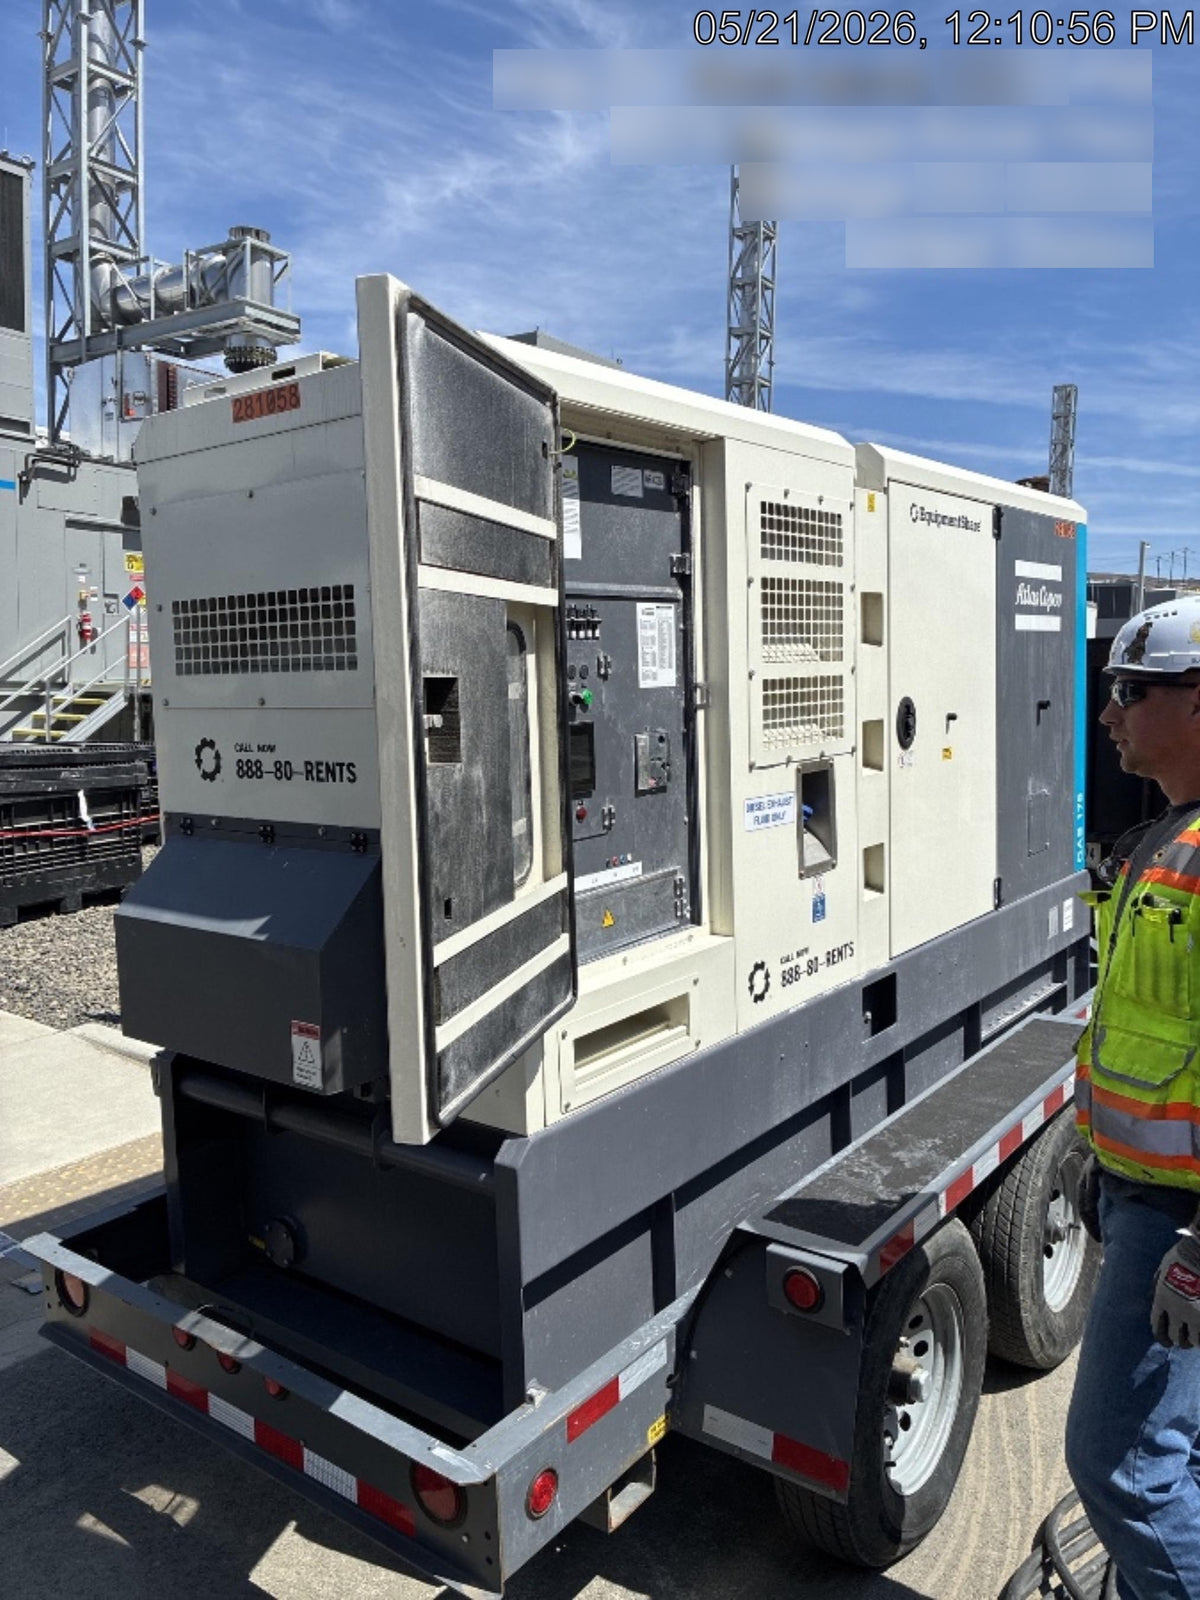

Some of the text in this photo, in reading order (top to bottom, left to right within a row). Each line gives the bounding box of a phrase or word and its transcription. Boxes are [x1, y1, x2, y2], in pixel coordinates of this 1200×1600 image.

[232, 383, 300, 422] 281058
[1015, 582, 1039, 605] Atlas
[234, 743, 253, 753] CALL
[236, 758, 357, 784] 888-80-RENTS
[781, 941, 854, 987] 888-80-RENTS
